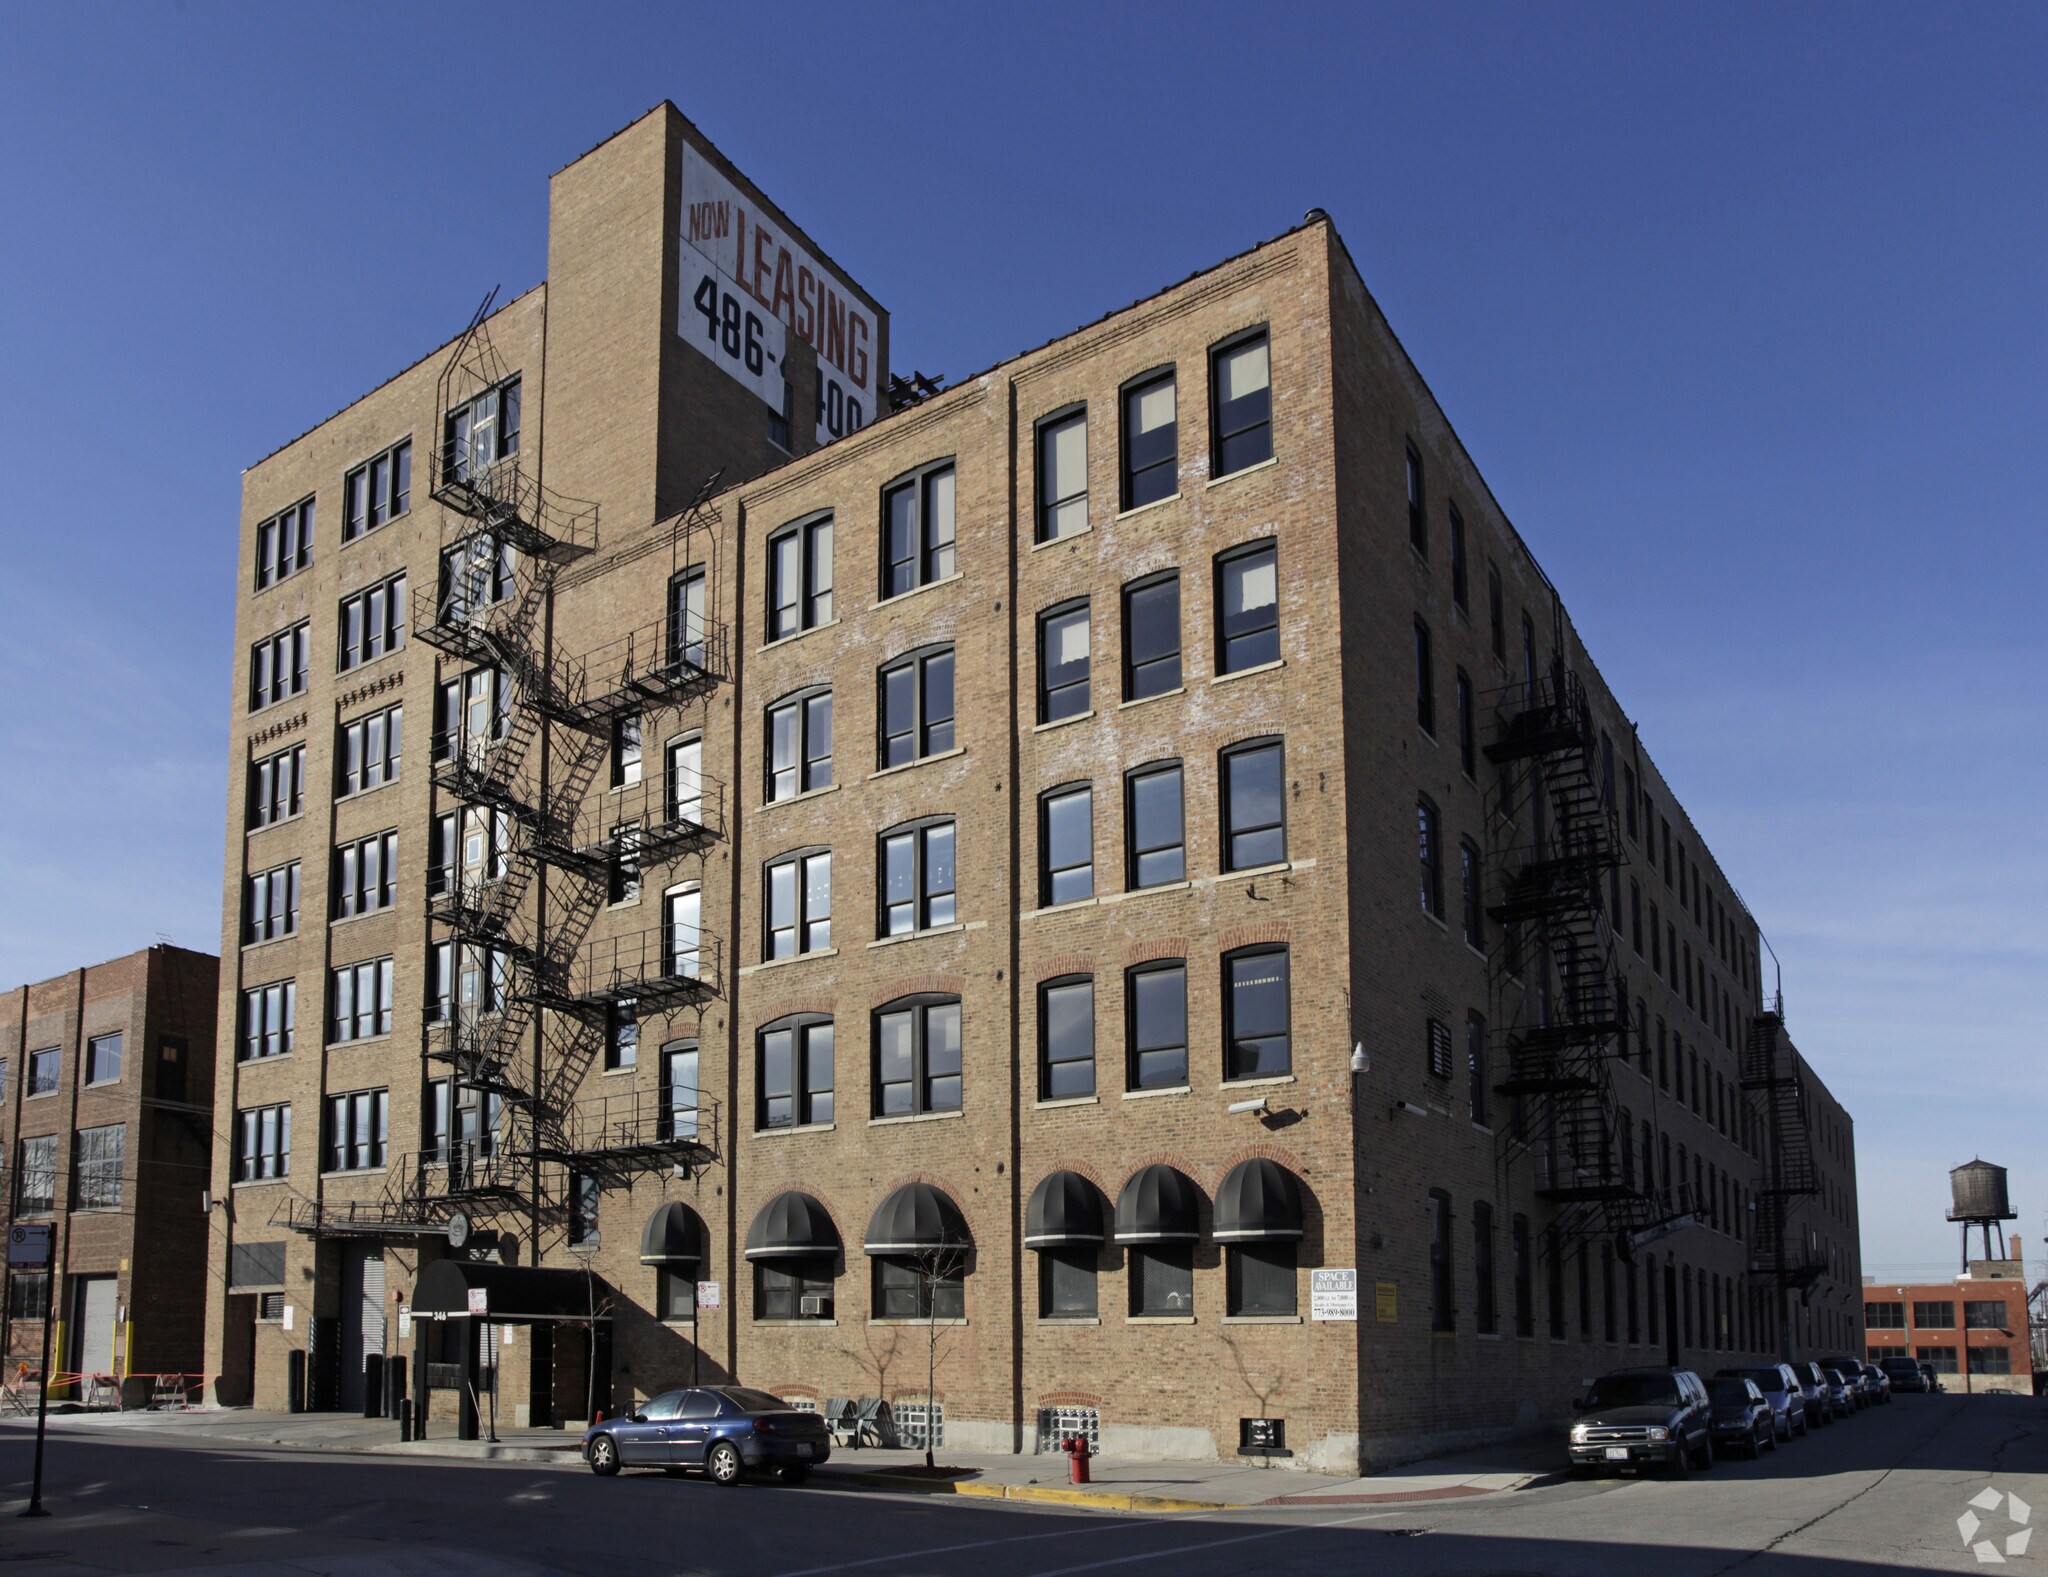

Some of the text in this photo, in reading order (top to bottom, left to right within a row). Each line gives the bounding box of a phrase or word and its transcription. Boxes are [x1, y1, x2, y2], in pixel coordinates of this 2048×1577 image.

[688, 200, 868, 391] NOW LEASING
[1318, 1271, 1349, 1281] SPACE
[1314, 1281, 1354, 1291] AVAILABLE
[433, 1311, 447, 1321] 346
